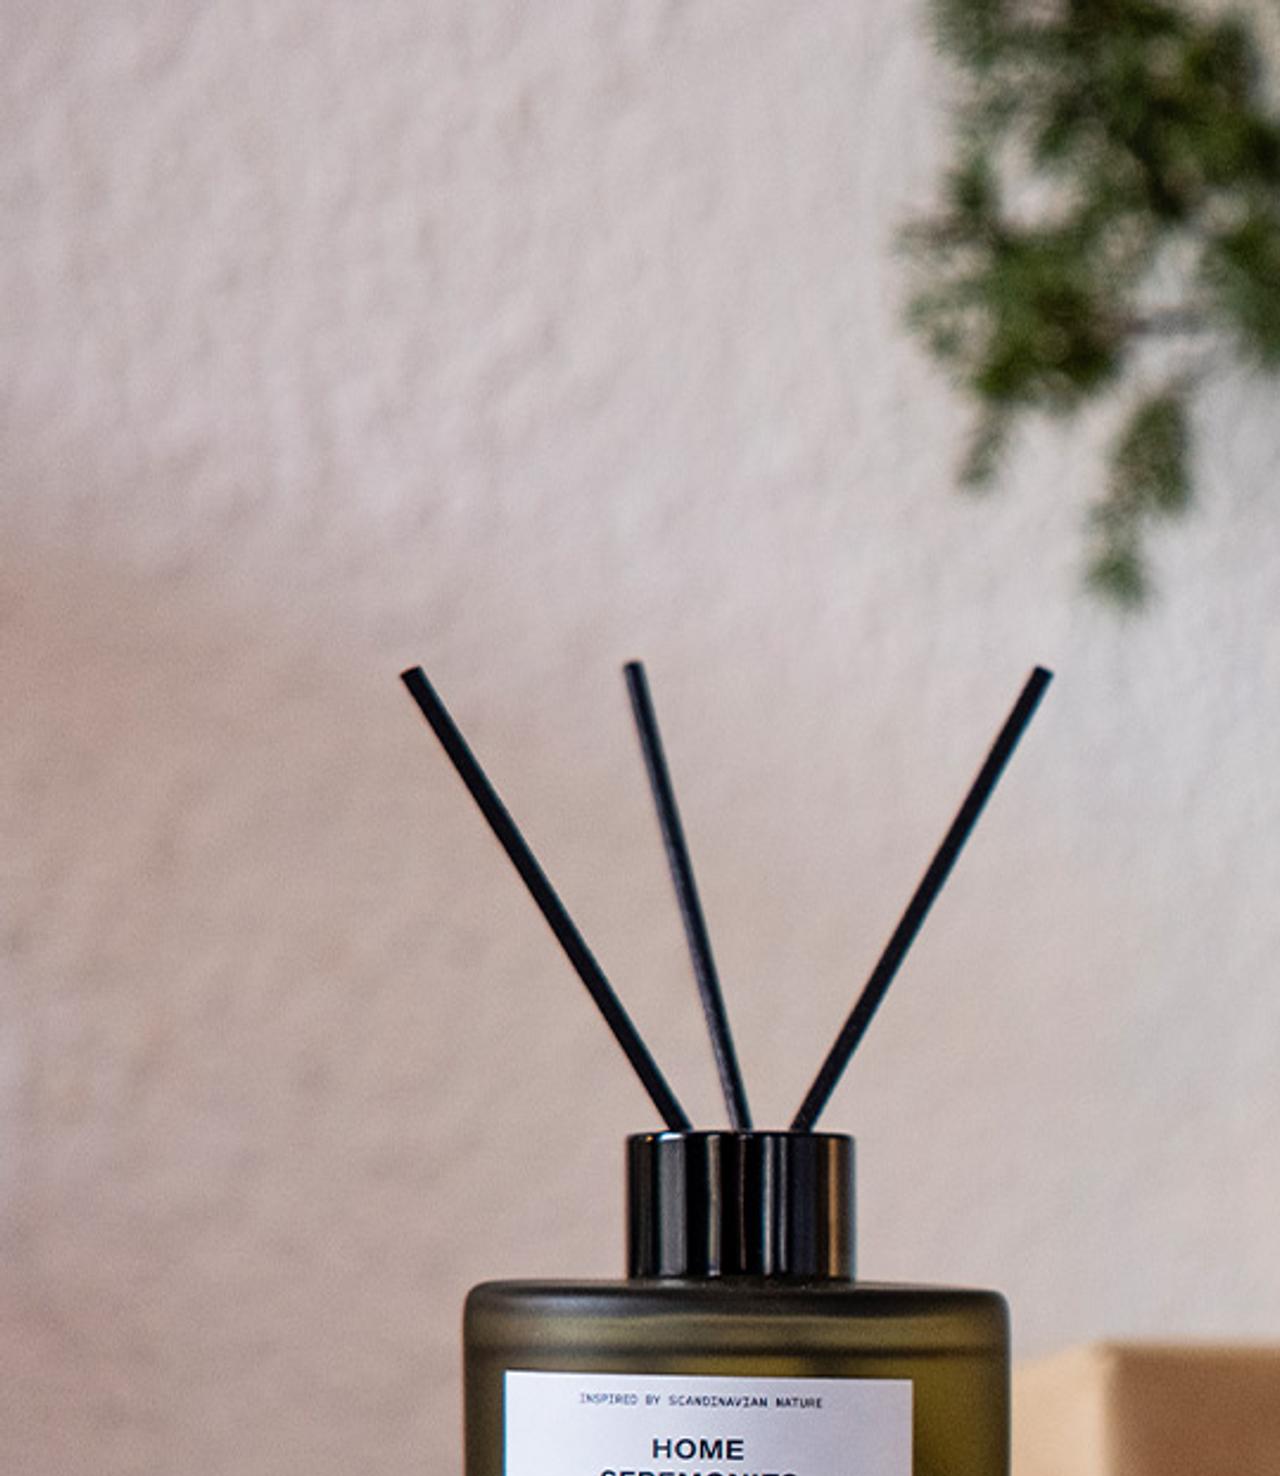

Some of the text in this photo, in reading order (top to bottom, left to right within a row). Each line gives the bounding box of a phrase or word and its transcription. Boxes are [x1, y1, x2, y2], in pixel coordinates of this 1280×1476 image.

[581, 1393, 822, 1408] INSPIRED BY SCANDINAVIAN NATURE
[652, 1438, 744, 1460] HOME
